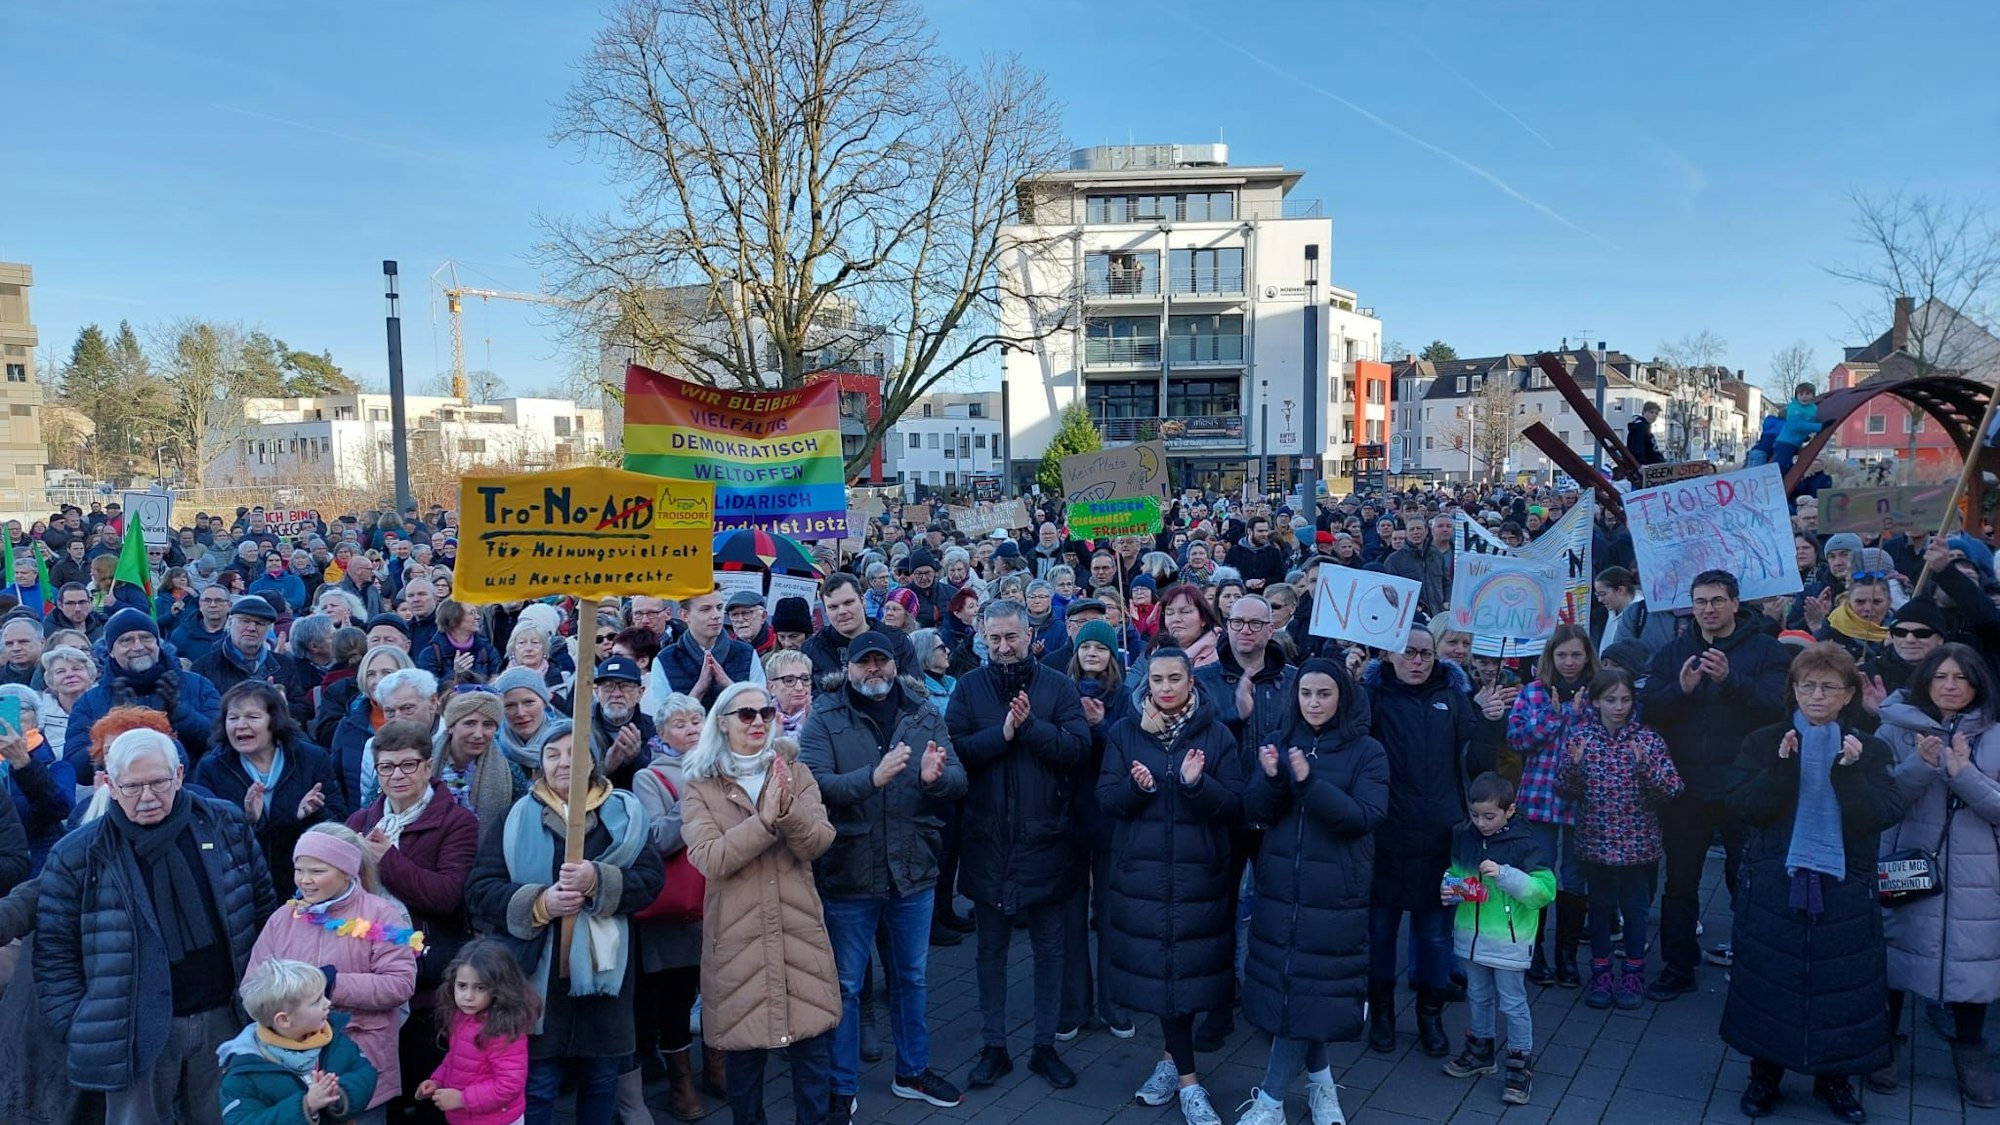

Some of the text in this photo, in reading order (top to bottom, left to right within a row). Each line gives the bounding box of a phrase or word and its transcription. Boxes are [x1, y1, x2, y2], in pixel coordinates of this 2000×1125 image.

[681, 384, 803, 412] WIR BLEIBEN:
[690, 409, 788, 435] VIELFÄLTIG
[672, 433, 818, 458] DEMOKRATISCH
[694, 463, 804, 482] WELTOFFEN
[1646, 466, 1673, 479] GEGEN
[714, 492, 812, 509] LIDARISCH
[1089, 501, 1145, 514] FRIEDEN
[1626, 475, 1780, 524] TROISDORF
[265, 512, 284, 522] ICH
[477, 487, 653, 530] Tro-No-AfD
[657, 511, 710, 520] TROISDORF
[773, 519, 800, 533] Ist
[805, 518, 847, 533] Jetz
[1092, 523, 1148, 536] FREIHEIT
[485, 541, 698, 561] Für Meinungsvielfalt
[485, 569, 673, 587] und Menschenrechte
[1474, 605, 1537, 632] BUNT
[1888, 862, 1908, 872] LOVE
[1909, 860, 1928, 871] MOS
[1880, 878, 1921, 890] MOSCHINO
